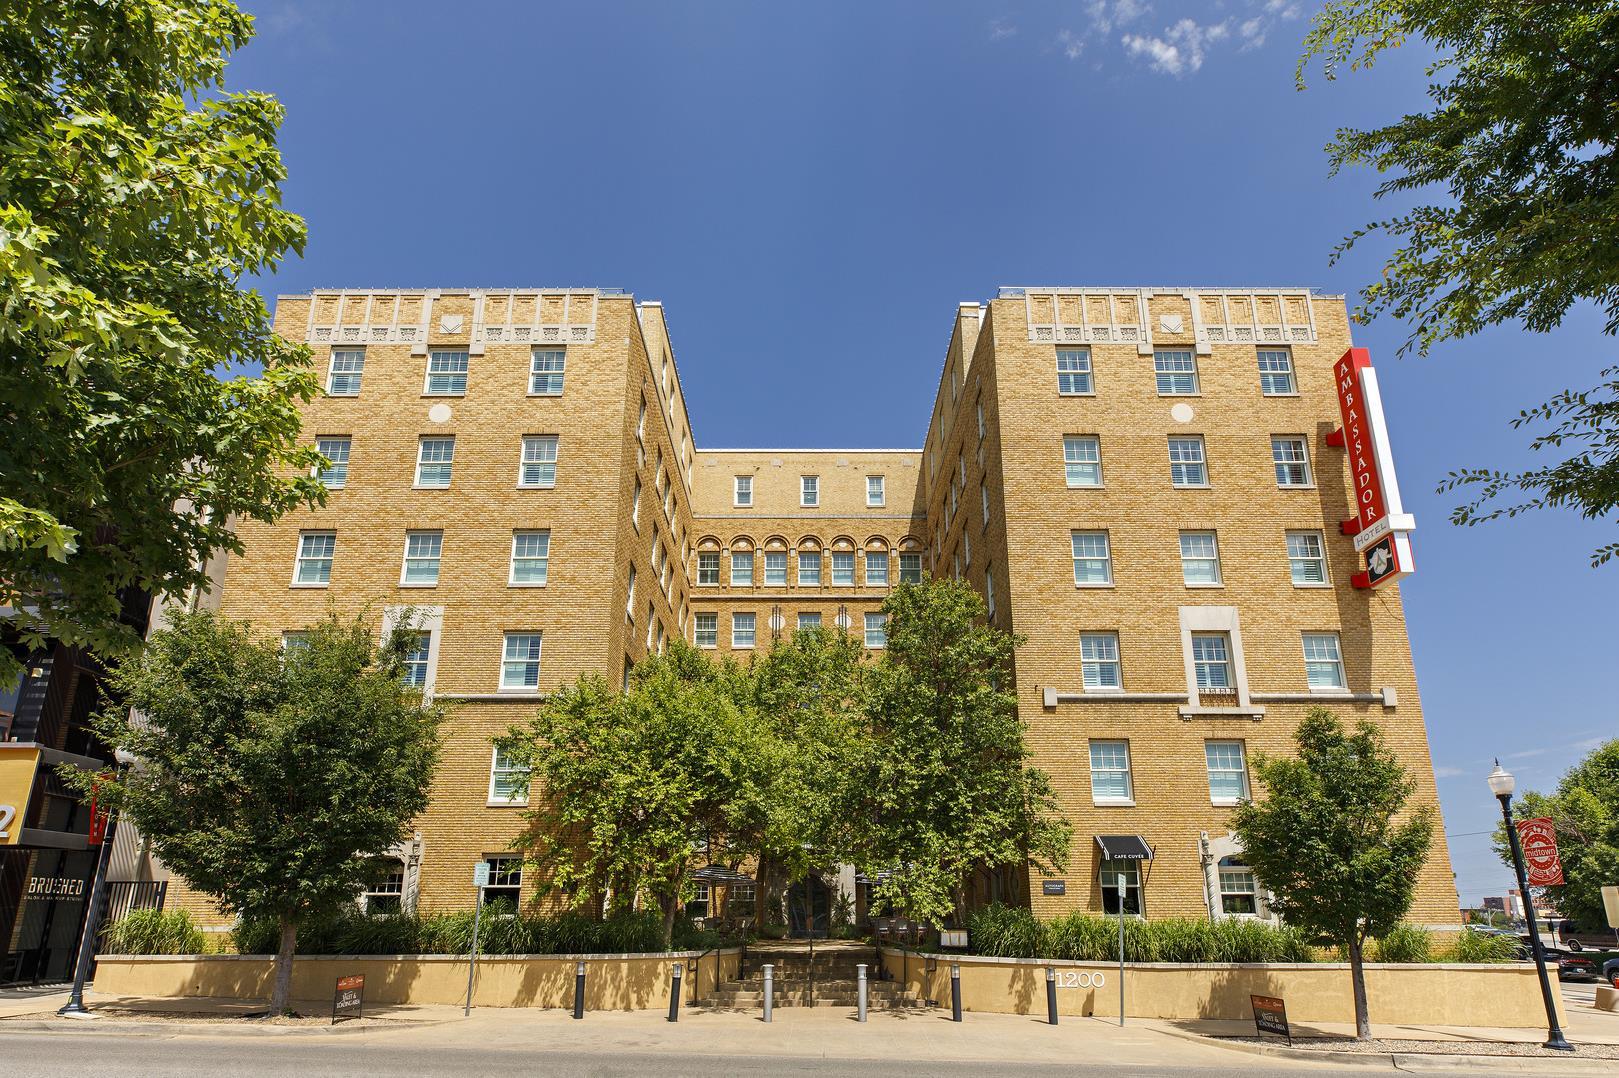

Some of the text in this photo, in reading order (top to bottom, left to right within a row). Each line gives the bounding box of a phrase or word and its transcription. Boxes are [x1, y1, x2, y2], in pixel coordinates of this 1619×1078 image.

[1338, 361, 1376, 522] AMBASSADOR
[1356, 523, 1387, 547] HOTEL
[1525, 848, 1556, 858] midtown
[28, 877, 84, 895] BRUSHED
[1056, 972, 1104, 988] 1200
